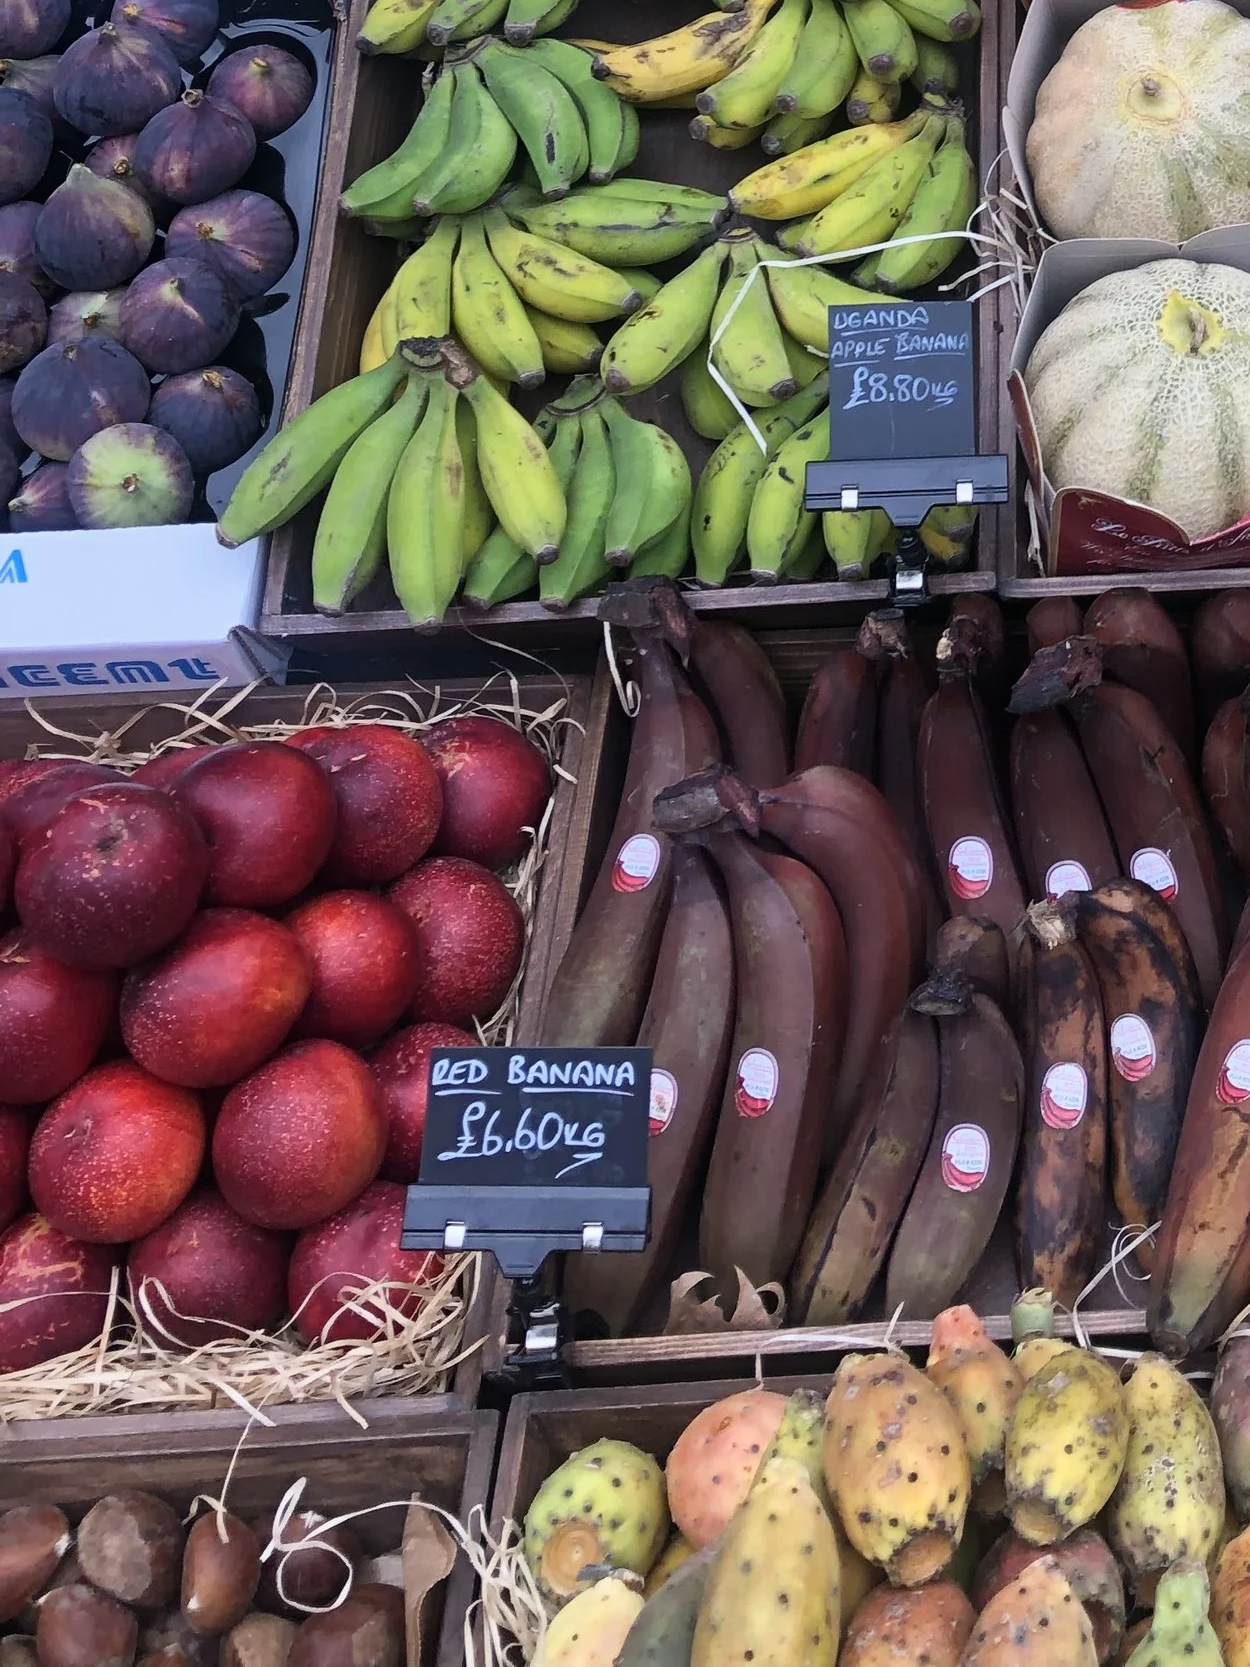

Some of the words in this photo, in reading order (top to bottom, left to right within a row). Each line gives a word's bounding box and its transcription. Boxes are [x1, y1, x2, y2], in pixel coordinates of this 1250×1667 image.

[834, 306, 929, 330] UGANDA
[831, 338, 890, 359] APPLE
[894, 331, 969, 355] BANANA
[432, 1057, 488, 1085] RED
[507, 1055, 635, 1087] BANANA
